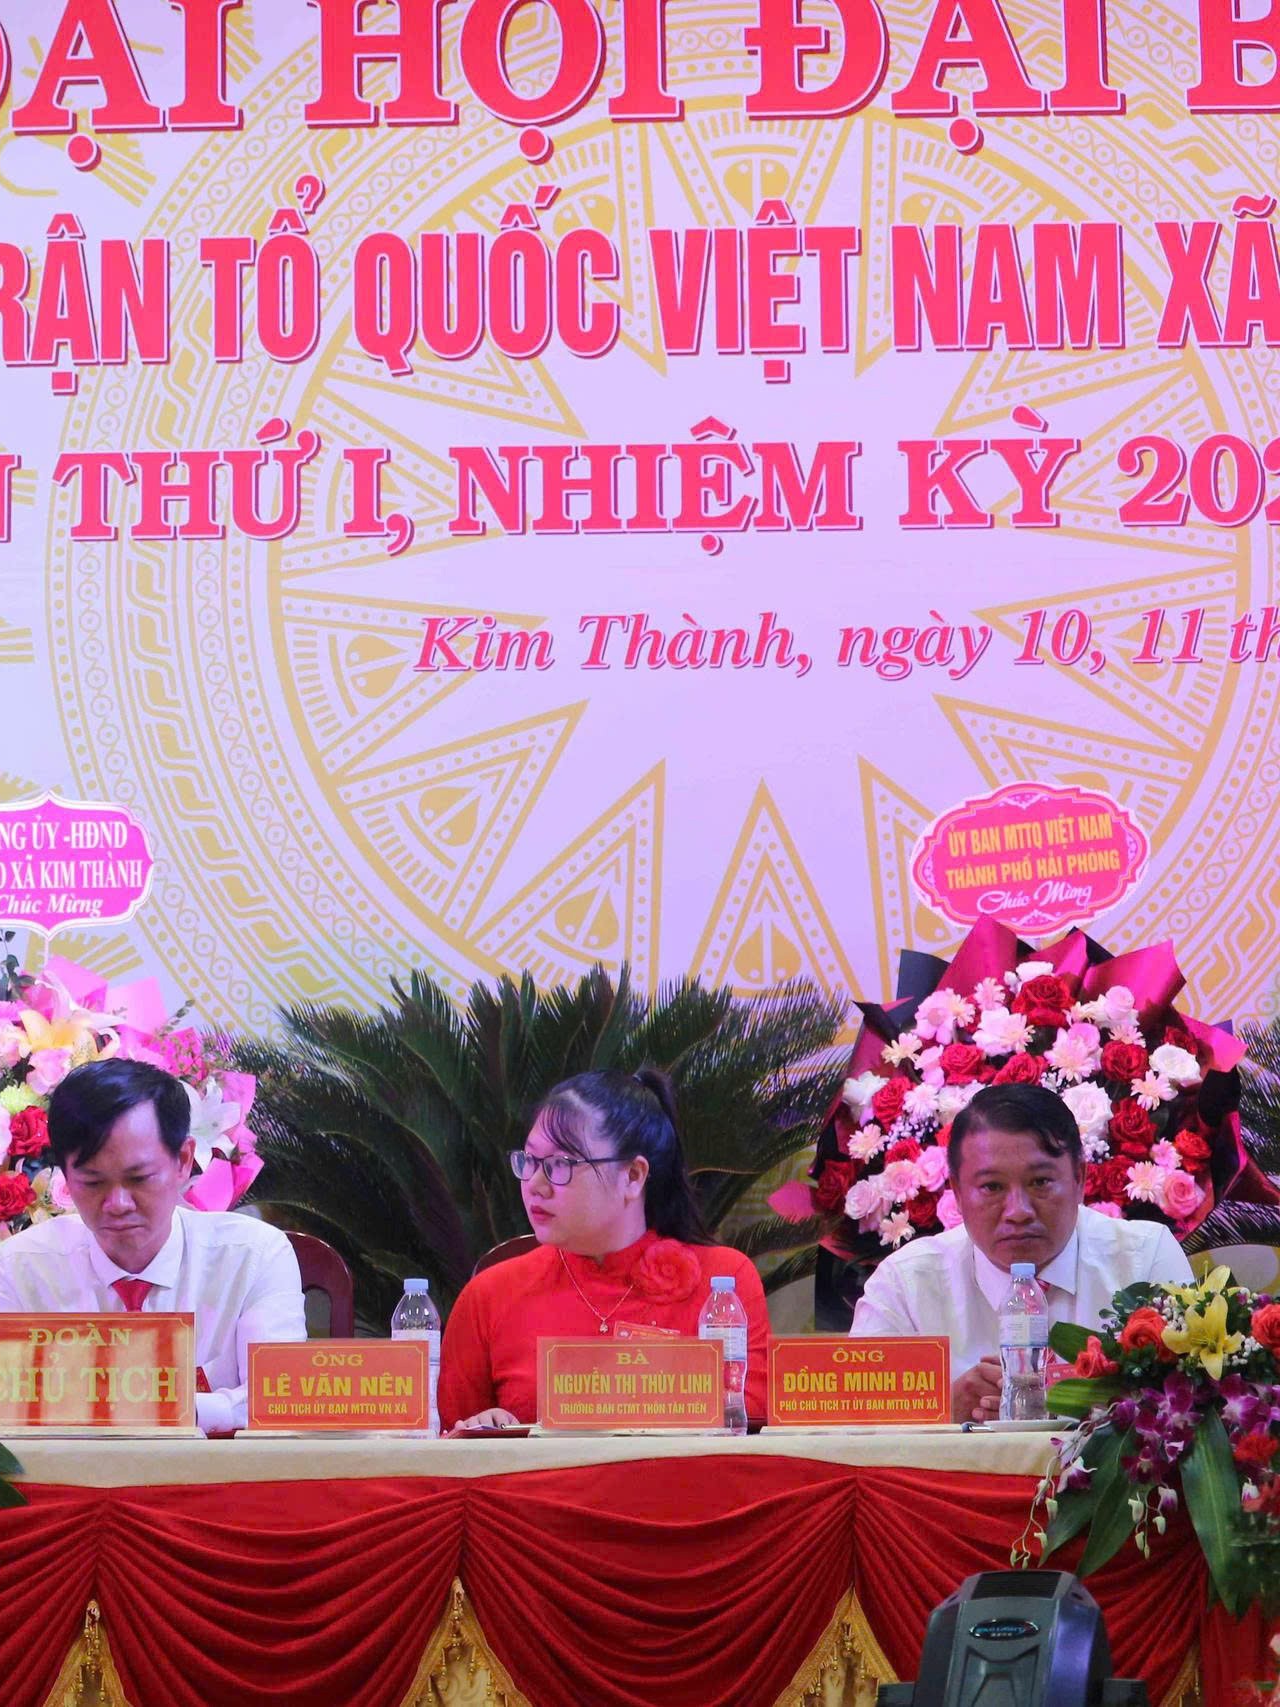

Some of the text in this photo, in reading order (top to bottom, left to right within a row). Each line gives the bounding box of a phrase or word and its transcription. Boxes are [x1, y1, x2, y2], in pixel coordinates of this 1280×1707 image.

[744, 0, 1127, 153] ĐẠI
[199, 174, 325, 365] TỔ
[352, 184, 621, 378] QUỐC
[648, 198, 861, 384] VIỆT
[890, 221, 1126, 354] NAM
[1153, 193, 1280, 350] XÃ
[50, 416, 322, 545] THỨ
[341, 446, 416, 557] I,
[447, 414, 866, 556] NHIỆM
[896, 404, 1082, 531] KỲ
[1116, 433, 1280, 529] 20
[412, 614, 556, 673] Kim
[578, 611, 813, 678] Thành,
[837, 610, 993, 681] ngày
[1014, 608, 1106, 675] 10,
[1131, 607, 1206, 664] 11
[32, 815, 60, 850] ỦY
[947, 812, 1113, 857] ỦY BAN MTTQ VIỆT NAM
[10, 854, 36, 890] XÃ
[40, 860, 76, 889] KIM
[79, 851, 143, 889] THÀNH
[945, 848, 1122, 889] THÀNH PHỐ HẢI PHÒNG
[46, 893, 104, 918] Mừng
[28, 1322, 132, 1347] ĐOÀN
[312, 1351, 364, 1367] ÔNG
[615, 1349, 649, 1365] BÀ
[832, 1347, 885, 1363] ÔNG
[79, 1366, 178, 1411] TỊCH
[263, 1372, 413, 1397] LÊ VĂN NÊN
[553, 1367, 610, 1394] NGUYỄN
[614, 1374, 637, 1398] THỊ
[679, 1374, 713, 1394] LINH
[783, 1365, 935, 1396] ĐỒNG MINH ĐẠI
[290, 1403, 311, 1416] TỊCH
[328, 1403, 348, 1414] BAN
[350, 1403, 376, 1415] MTTQ
[378, 1403, 392, 1414] VN
[596, 1402, 615, 1414] BAN
[617, 1402, 640, 1414] CTMT
[820, 1399, 839, 1412] TỊCH
[841, 1399, 851, 1410] TT
[866, 1399, 884, 1410] BAN
[886, 1399, 910, 1411] MTTQ
[912, 1398, 925, 1410] VN
